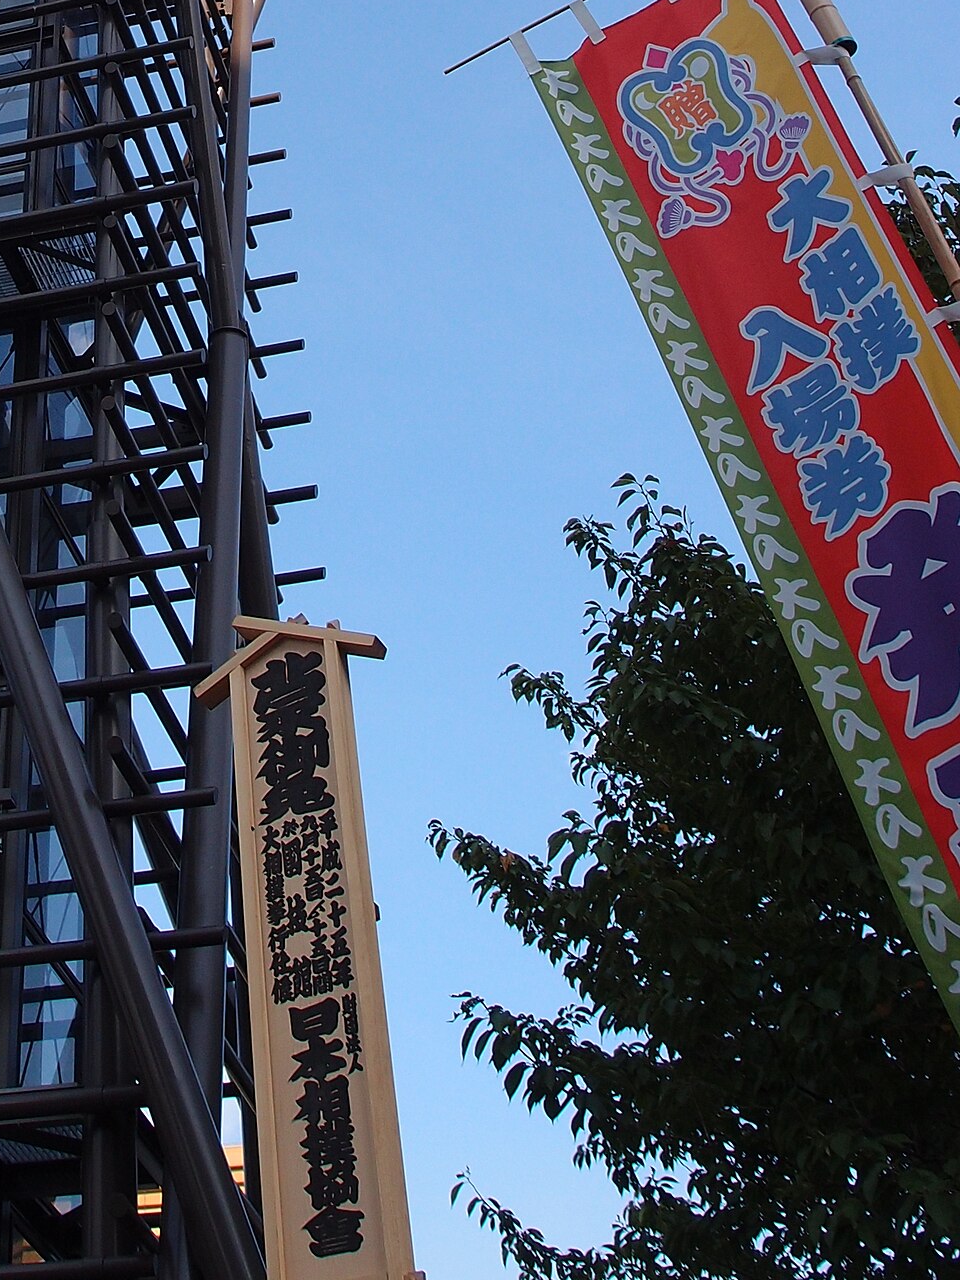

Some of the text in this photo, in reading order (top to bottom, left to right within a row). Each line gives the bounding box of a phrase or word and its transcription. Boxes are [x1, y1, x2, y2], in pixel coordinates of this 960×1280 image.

[659, 79, 714, 138] 贈
[772, 166, 921, 392] 大相撲
[741, 306, 890, 540] 入場券
